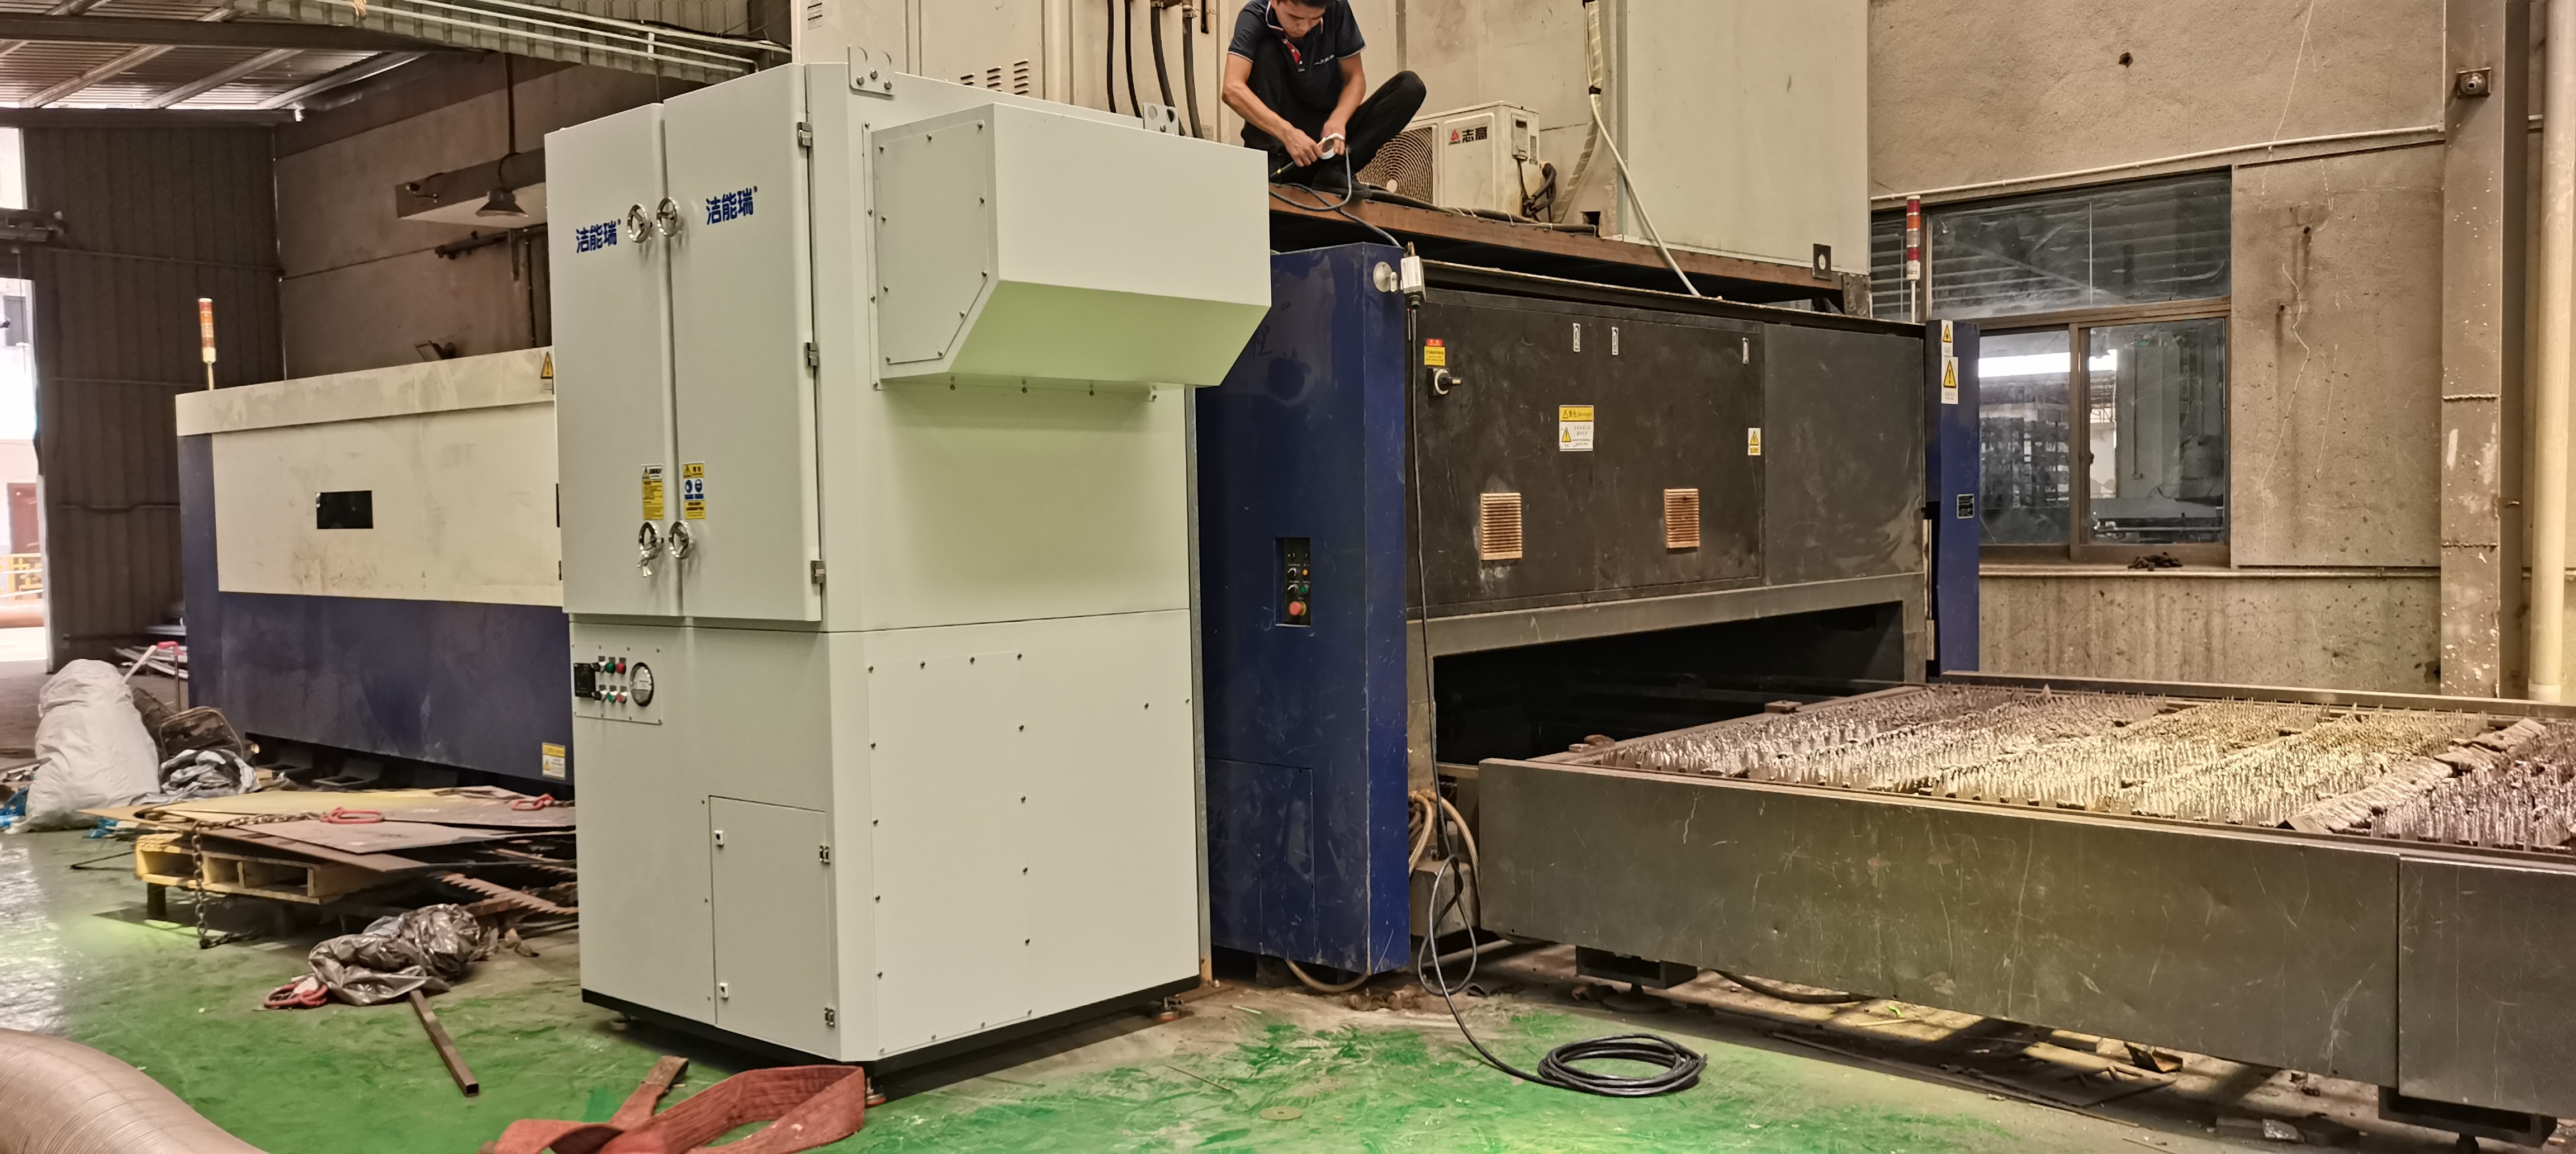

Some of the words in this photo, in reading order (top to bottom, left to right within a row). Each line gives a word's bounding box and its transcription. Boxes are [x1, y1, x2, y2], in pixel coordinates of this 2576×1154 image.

[1462, 126, 1488, 143] 志高
[706, 187, 753, 225] 洁能瑞
[576, 220, 617, 253] 洁能瑞
